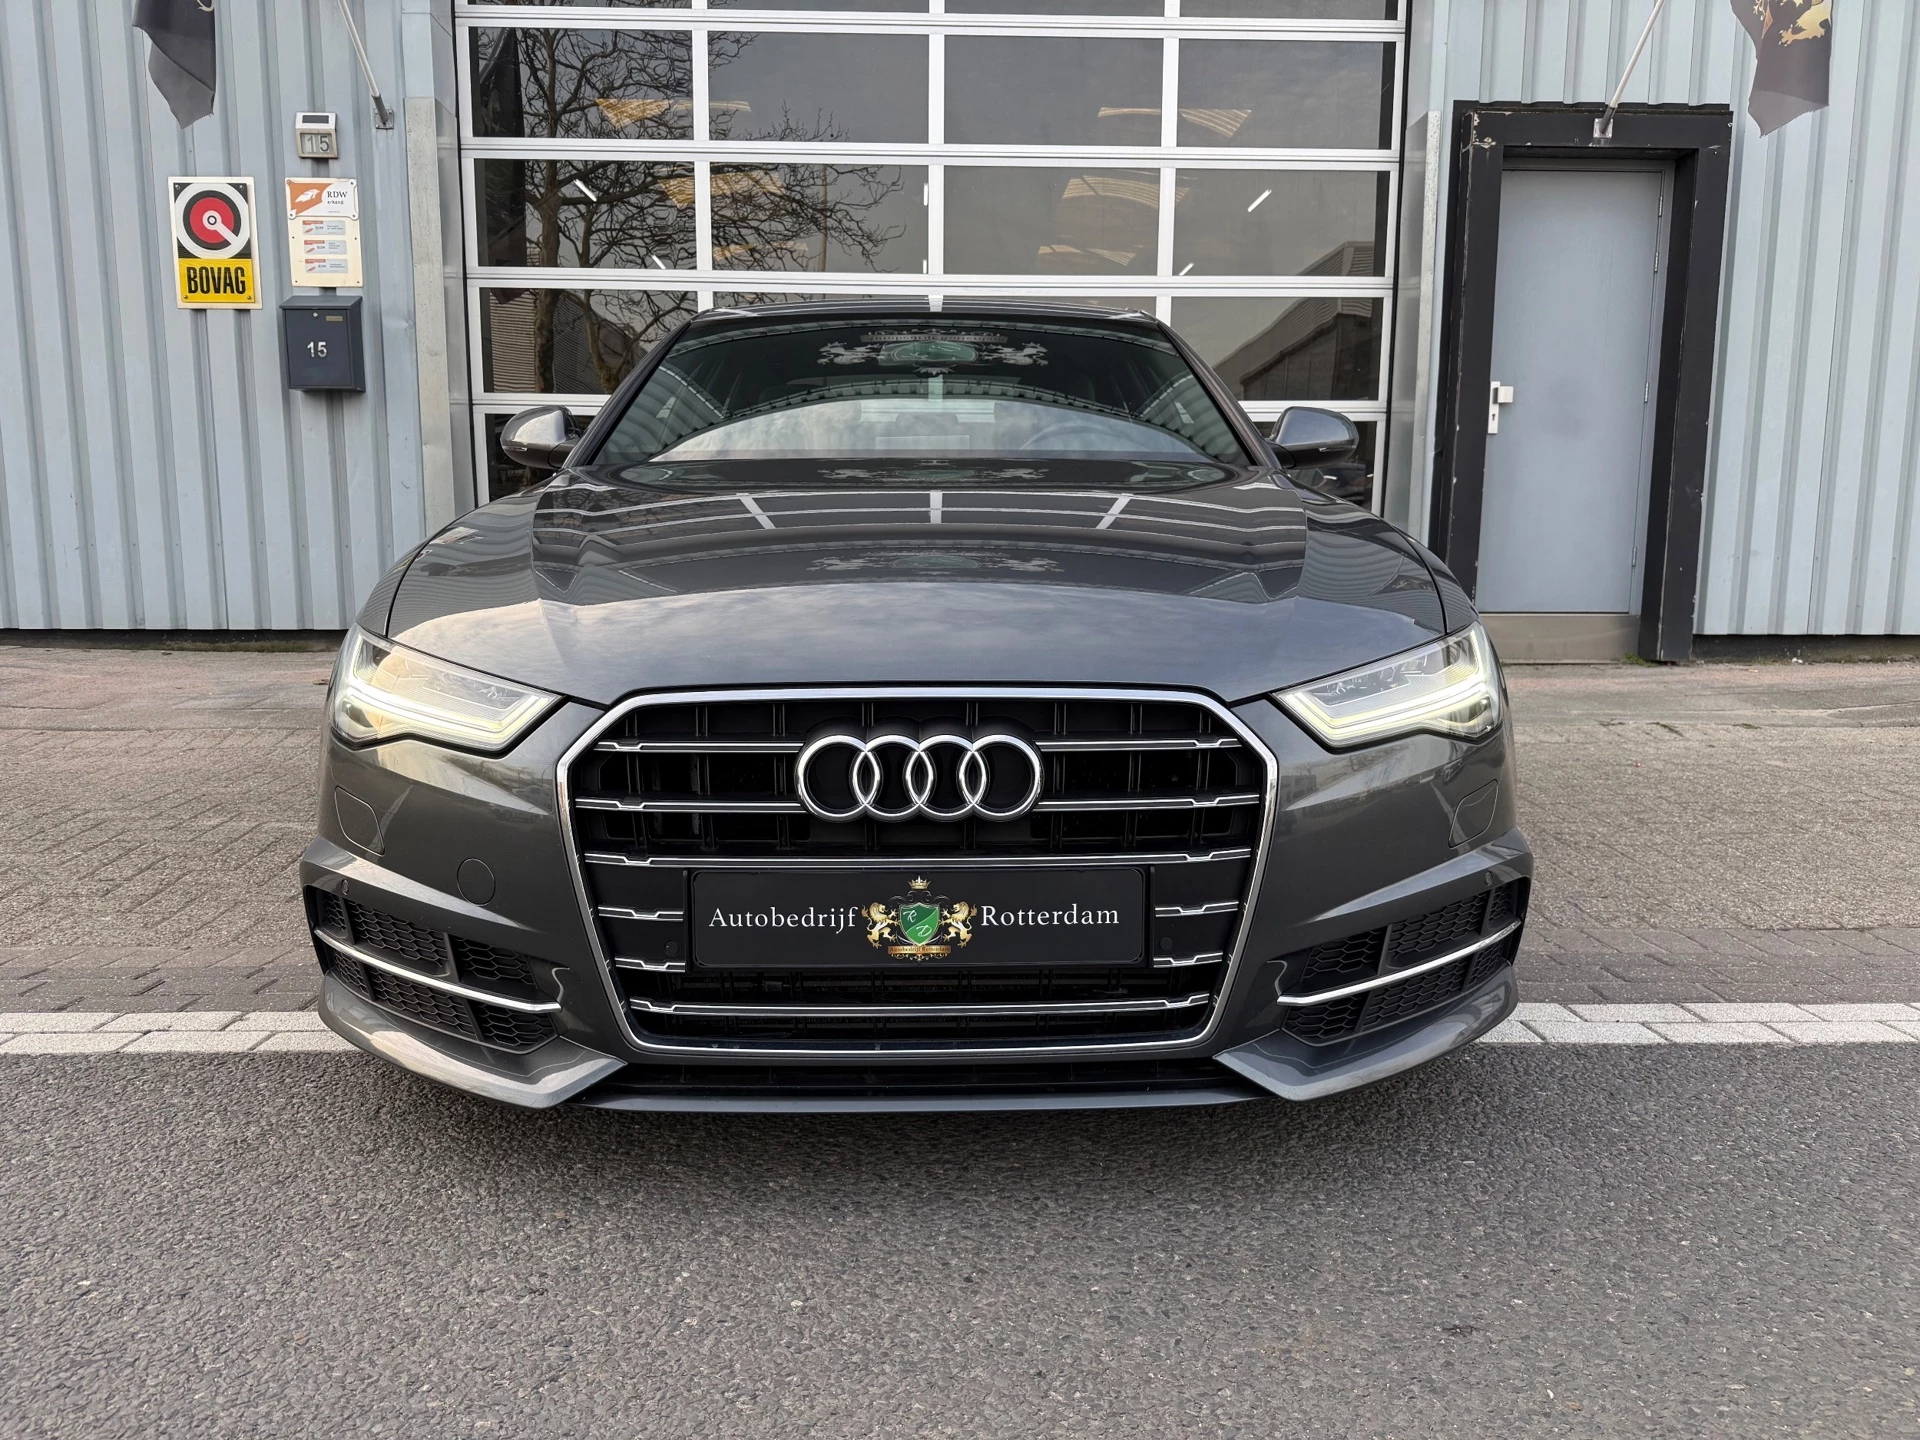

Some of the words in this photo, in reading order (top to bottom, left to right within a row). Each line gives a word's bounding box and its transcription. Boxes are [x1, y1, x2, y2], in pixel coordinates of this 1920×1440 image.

[307, 135, 330, 152] 15
[186, 266, 246, 294] BOVAG
[307, 341, 327, 357] 15
[708, 906, 859, 935] Autobedrijf
[980, 903, 1120, 927] Rotterdam
